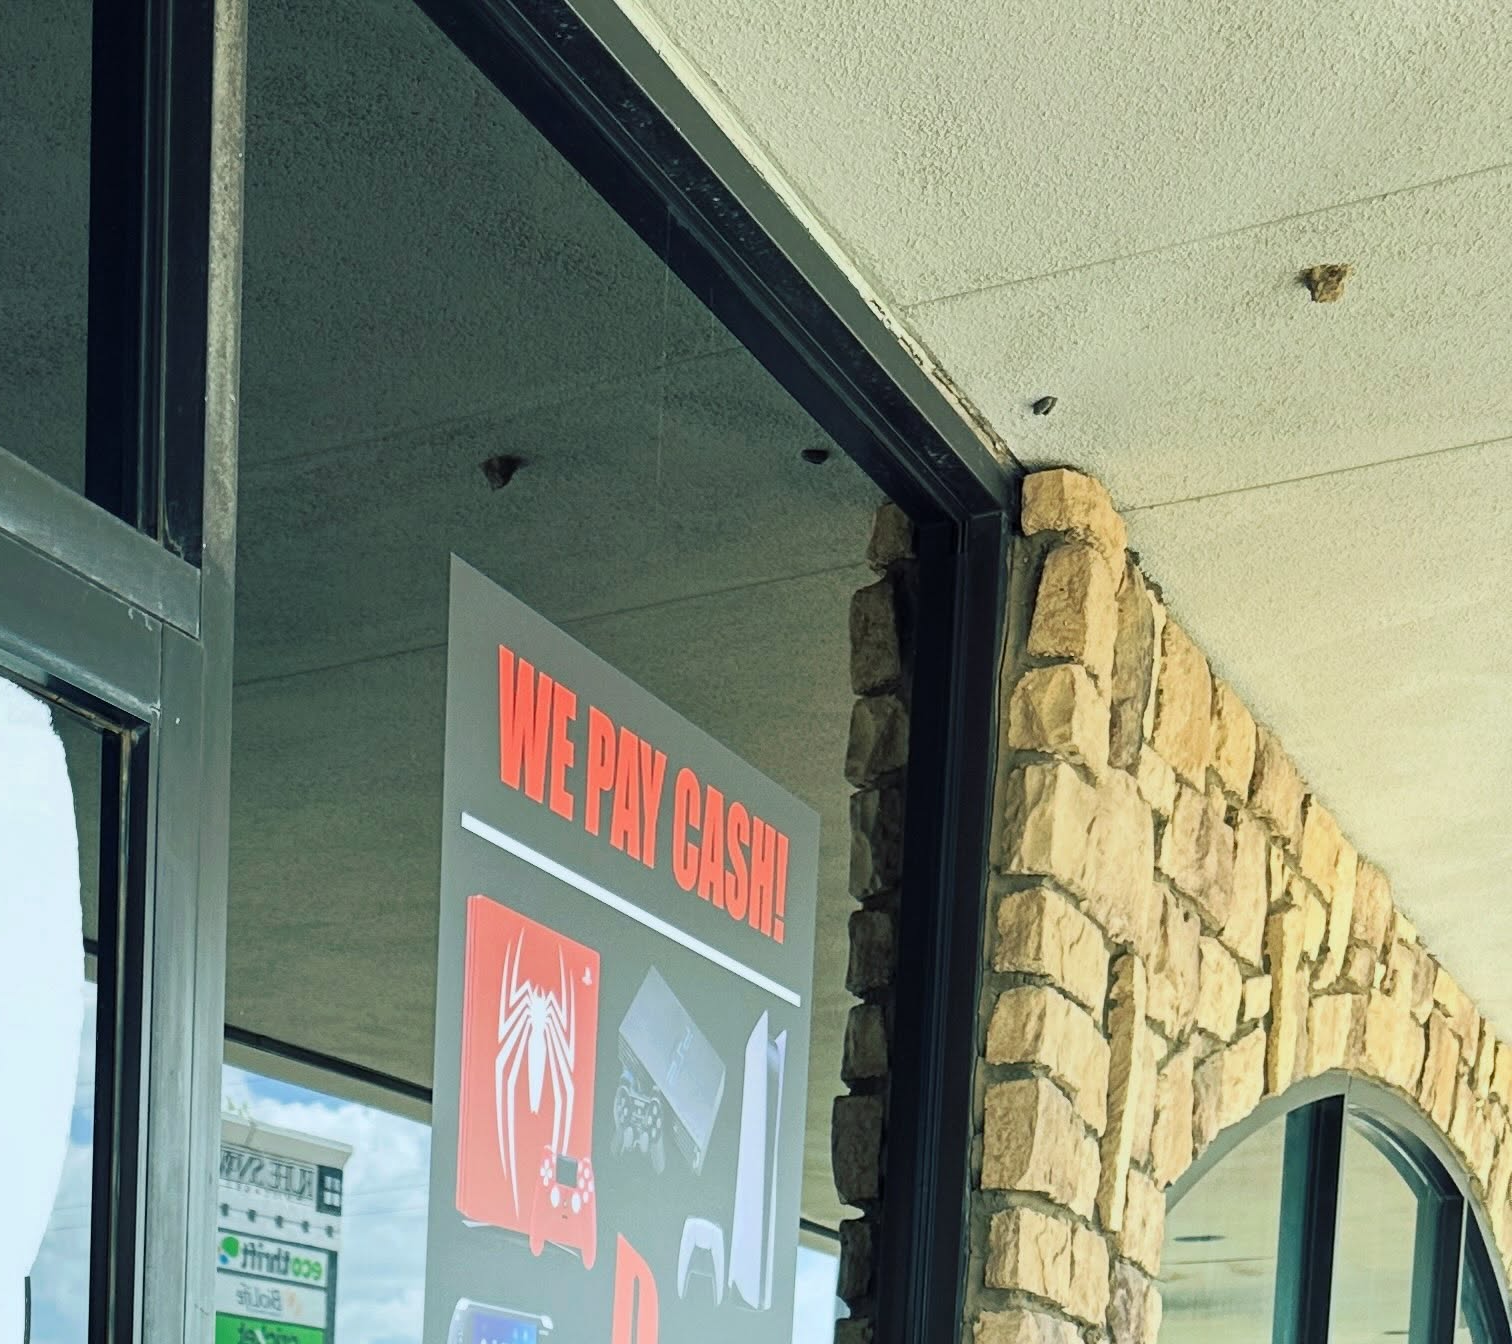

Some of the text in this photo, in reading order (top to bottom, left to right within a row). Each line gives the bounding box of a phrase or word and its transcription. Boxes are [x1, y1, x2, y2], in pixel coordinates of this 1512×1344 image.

[498, 644, 790, 944] WE PAY CASH!
